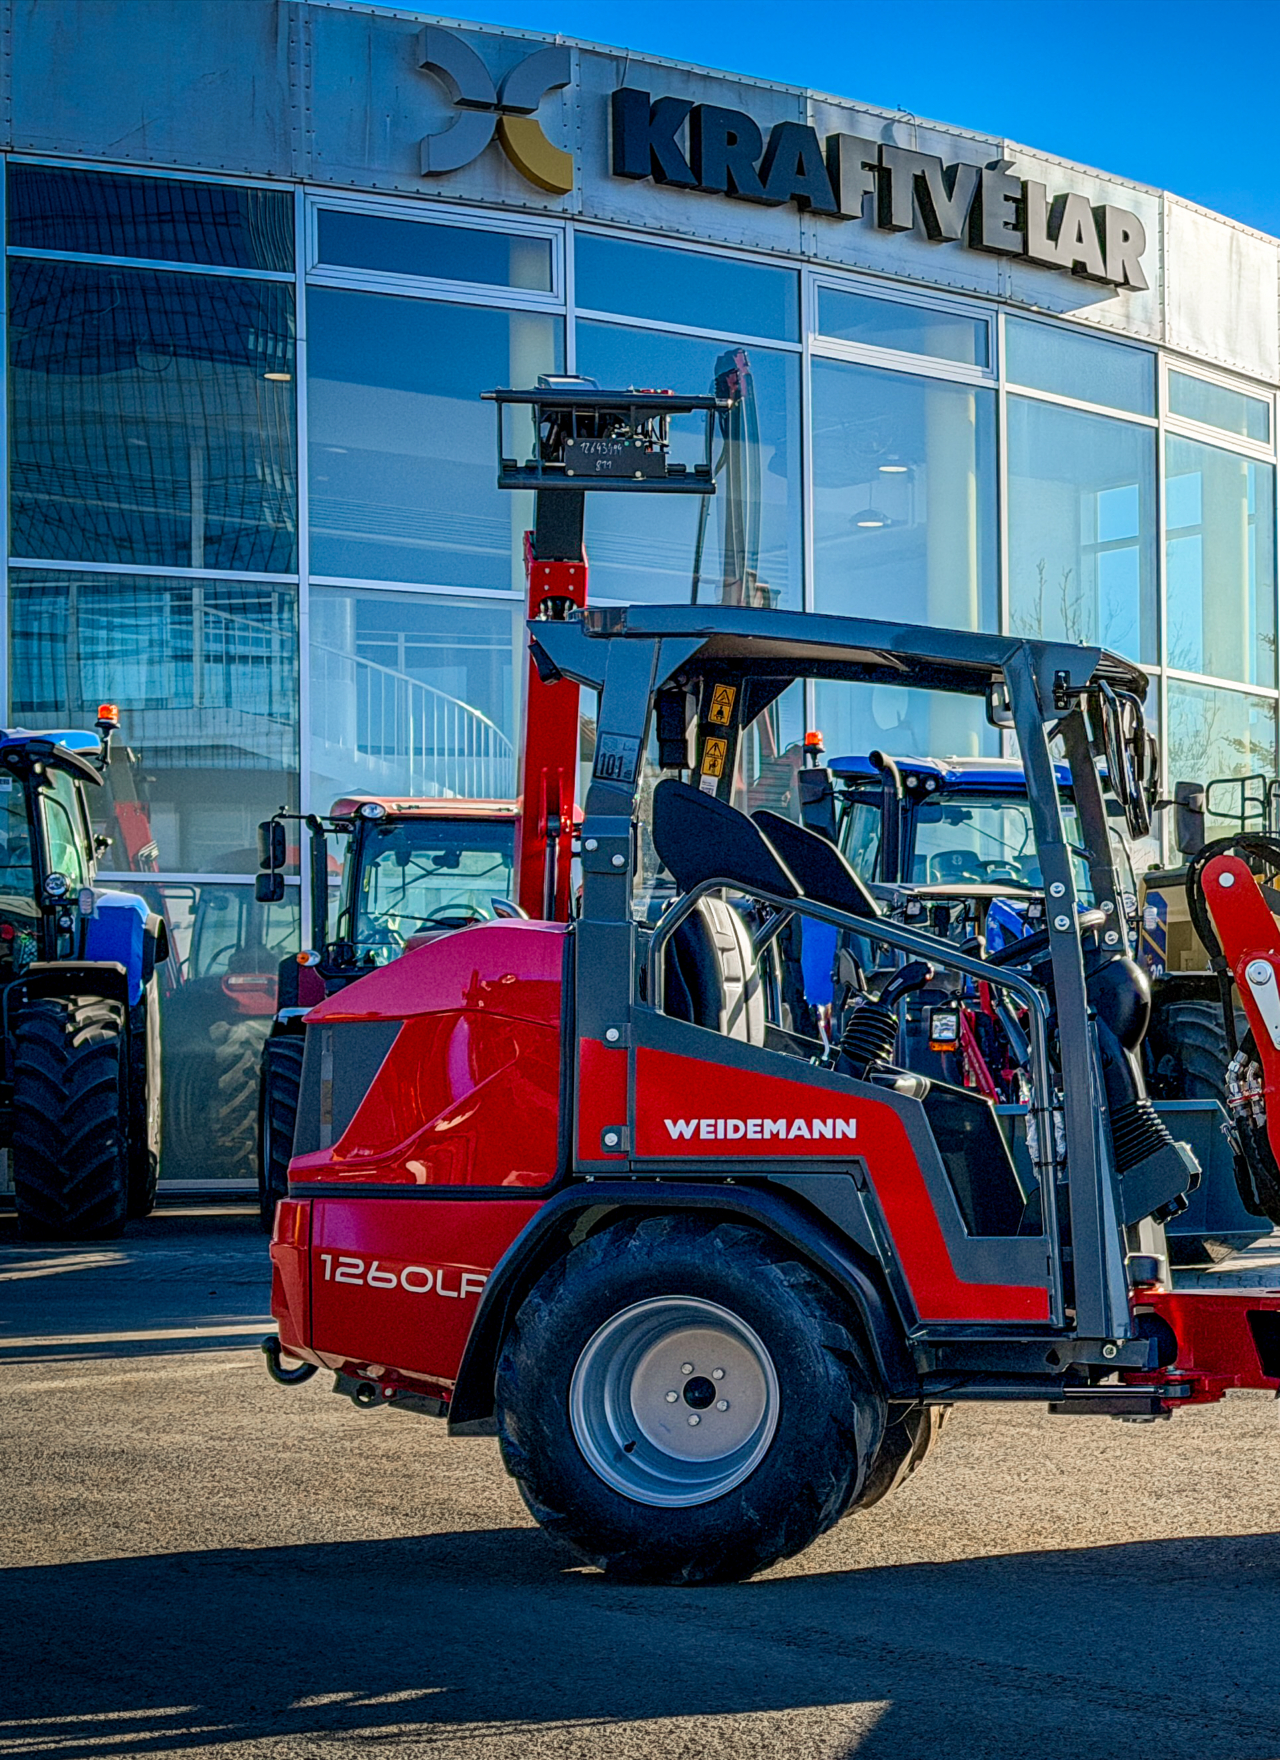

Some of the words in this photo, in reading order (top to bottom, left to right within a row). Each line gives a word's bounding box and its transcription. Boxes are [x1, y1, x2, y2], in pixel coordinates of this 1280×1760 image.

[611, 86, 1150, 292] KRAFTVÉLAR
[600, 753, 624, 778] 101
[663, 1118, 857, 1140] WEIDEMANN
